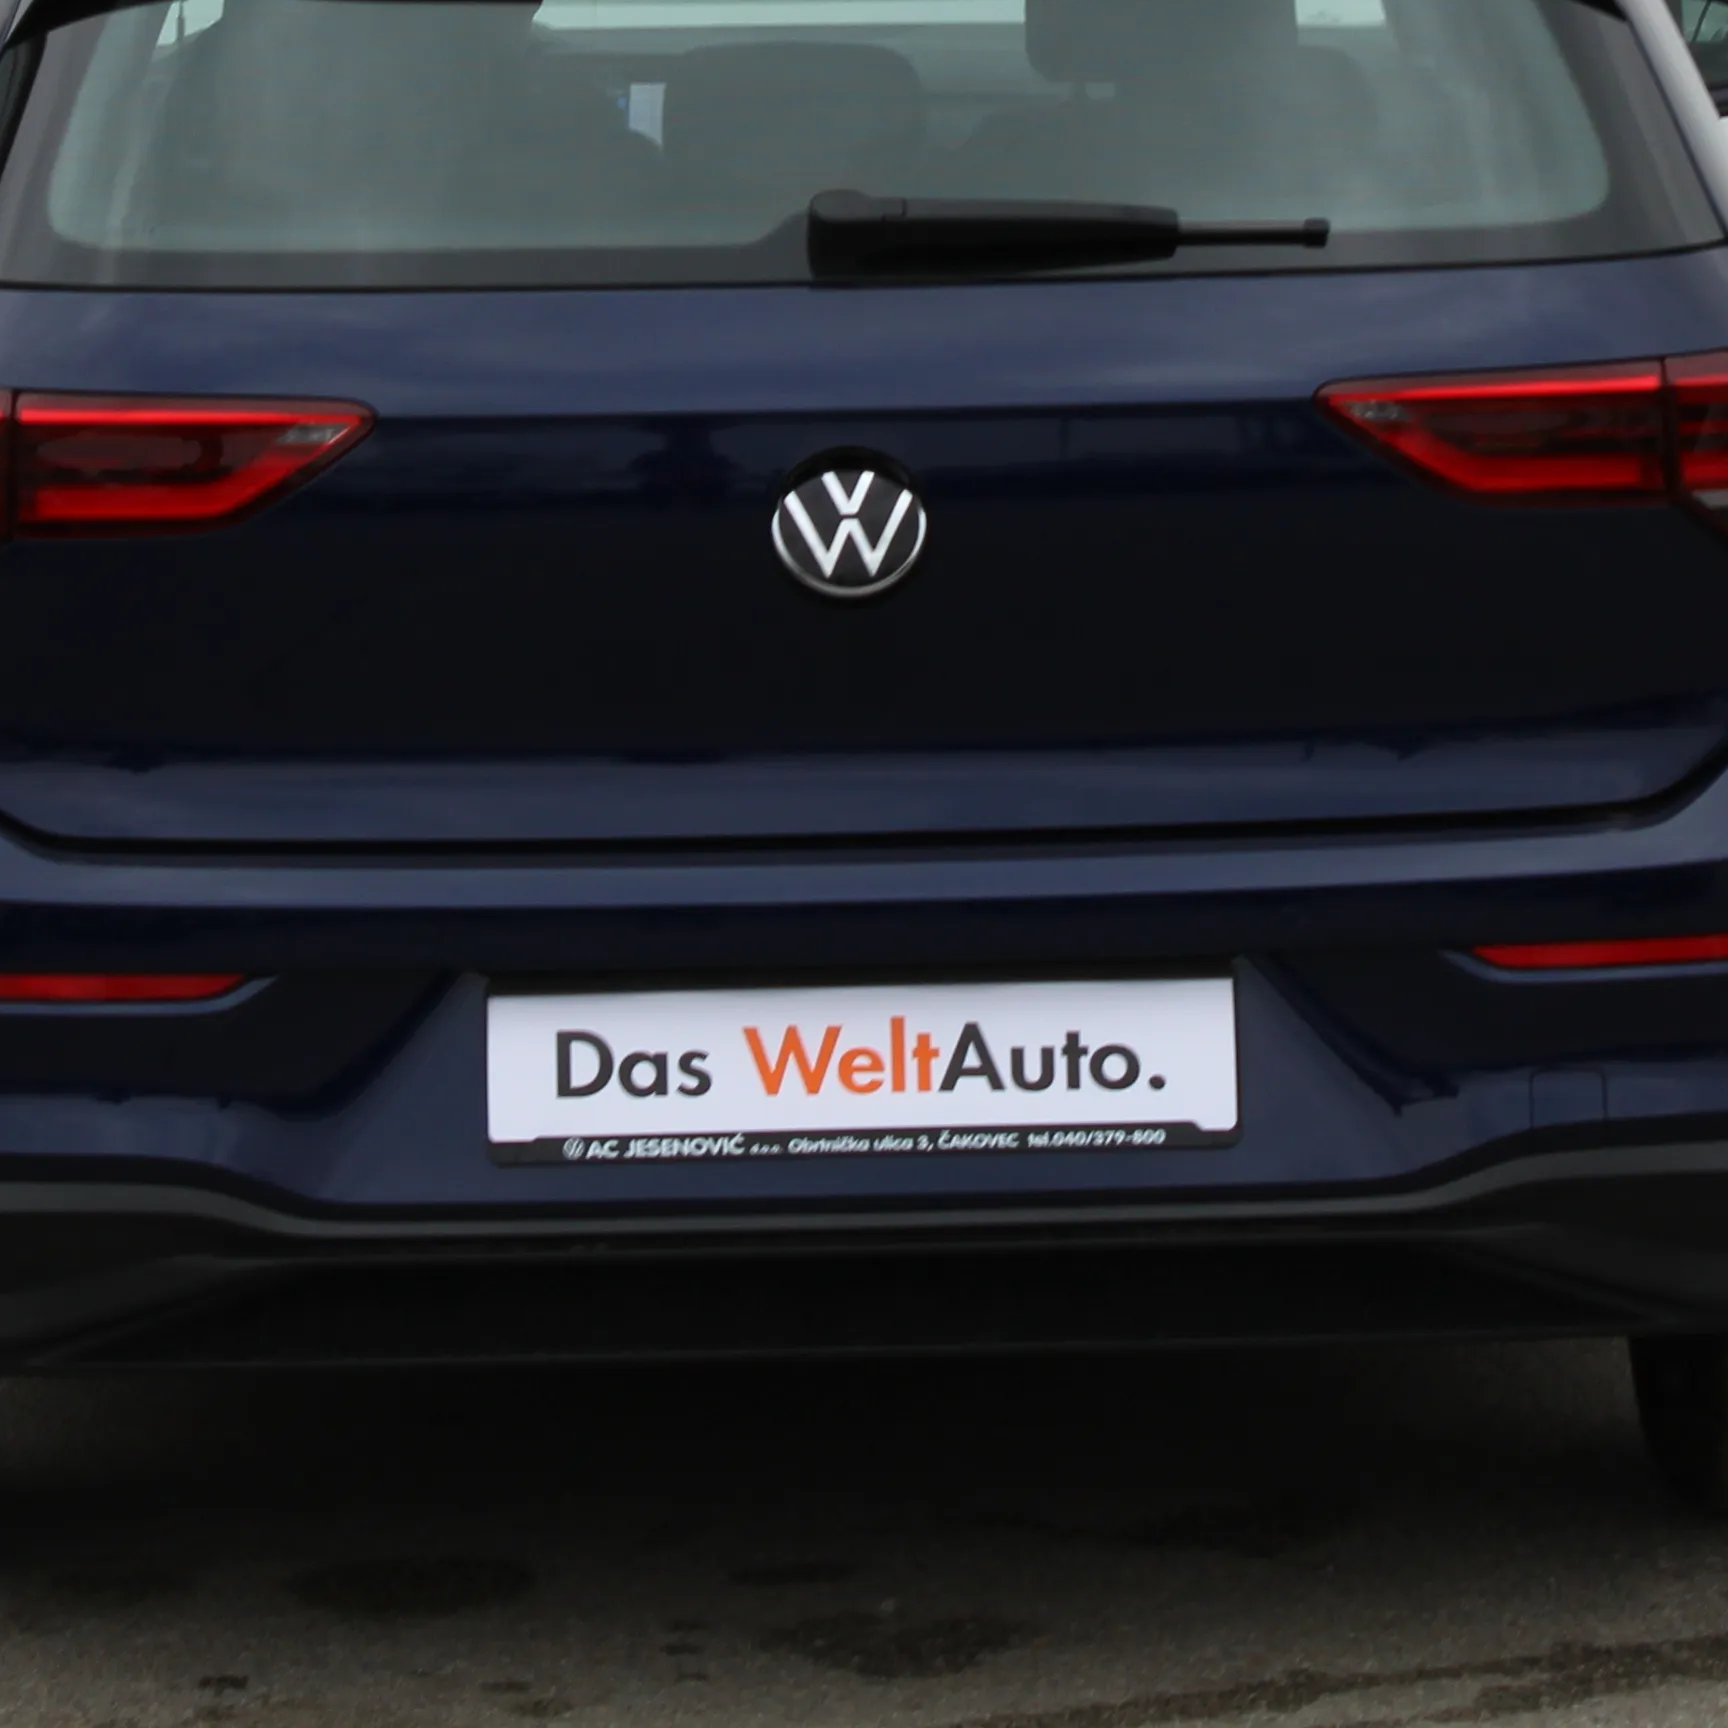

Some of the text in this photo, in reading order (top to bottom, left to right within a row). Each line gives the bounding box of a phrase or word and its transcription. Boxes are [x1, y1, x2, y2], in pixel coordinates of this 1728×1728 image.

[556, 1016, 1166, 1098] Das WeltAuto.
[585, 1139, 620, 1160] AC
[623, 1132, 746, 1159] JESENOVIĆ
[937, 1129, 1020, 1150] ČAKOVEC
